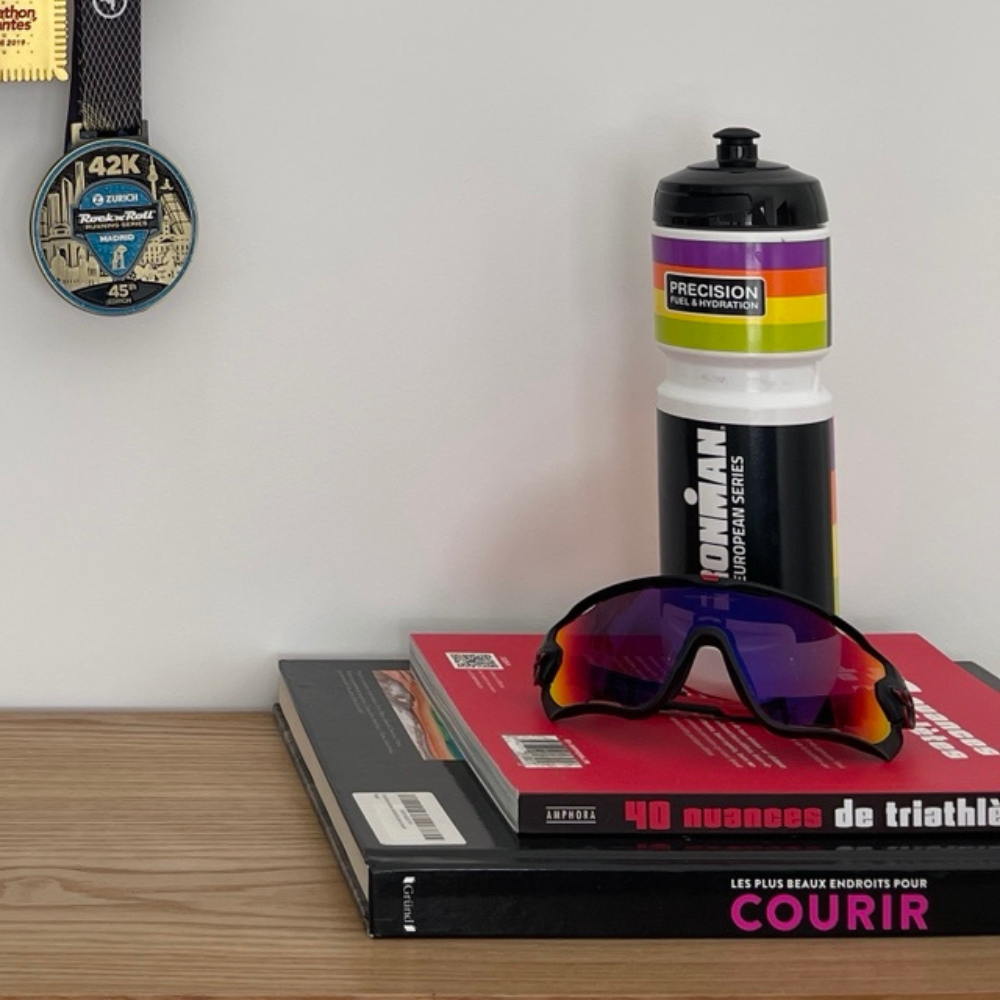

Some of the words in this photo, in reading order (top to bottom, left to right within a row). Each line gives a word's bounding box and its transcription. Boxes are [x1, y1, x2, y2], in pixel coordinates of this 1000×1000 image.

[88, 154, 141, 175] 42K
[106, 194, 138, 203] ZURICH
[100, 234, 134, 242] MADRID
[670, 281, 758, 299] PRECISION
[670, 296, 689, 306] FUEL
[691, 298, 698, 307] &
[700, 299, 759, 310] HYDRATION
[731, 456, 744, 504] SERIES
[546, 811, 596, 820] AMPHORA
[624, 801, 671, 830] 40
[684, 804, 822, 828] nuances
[835, 798, 873, 828] de
[731, 878, 752, 888] LES
[754, 878, 785, 888] PLUS
[787, 878, 827, 888] BEAUX
[829, 878, 890, 889] ENDROITS
[893, 878, 928, 888] POUR
[403, 885, 415, 923] Gründ
[731, 894, 929, 931] COURIR
